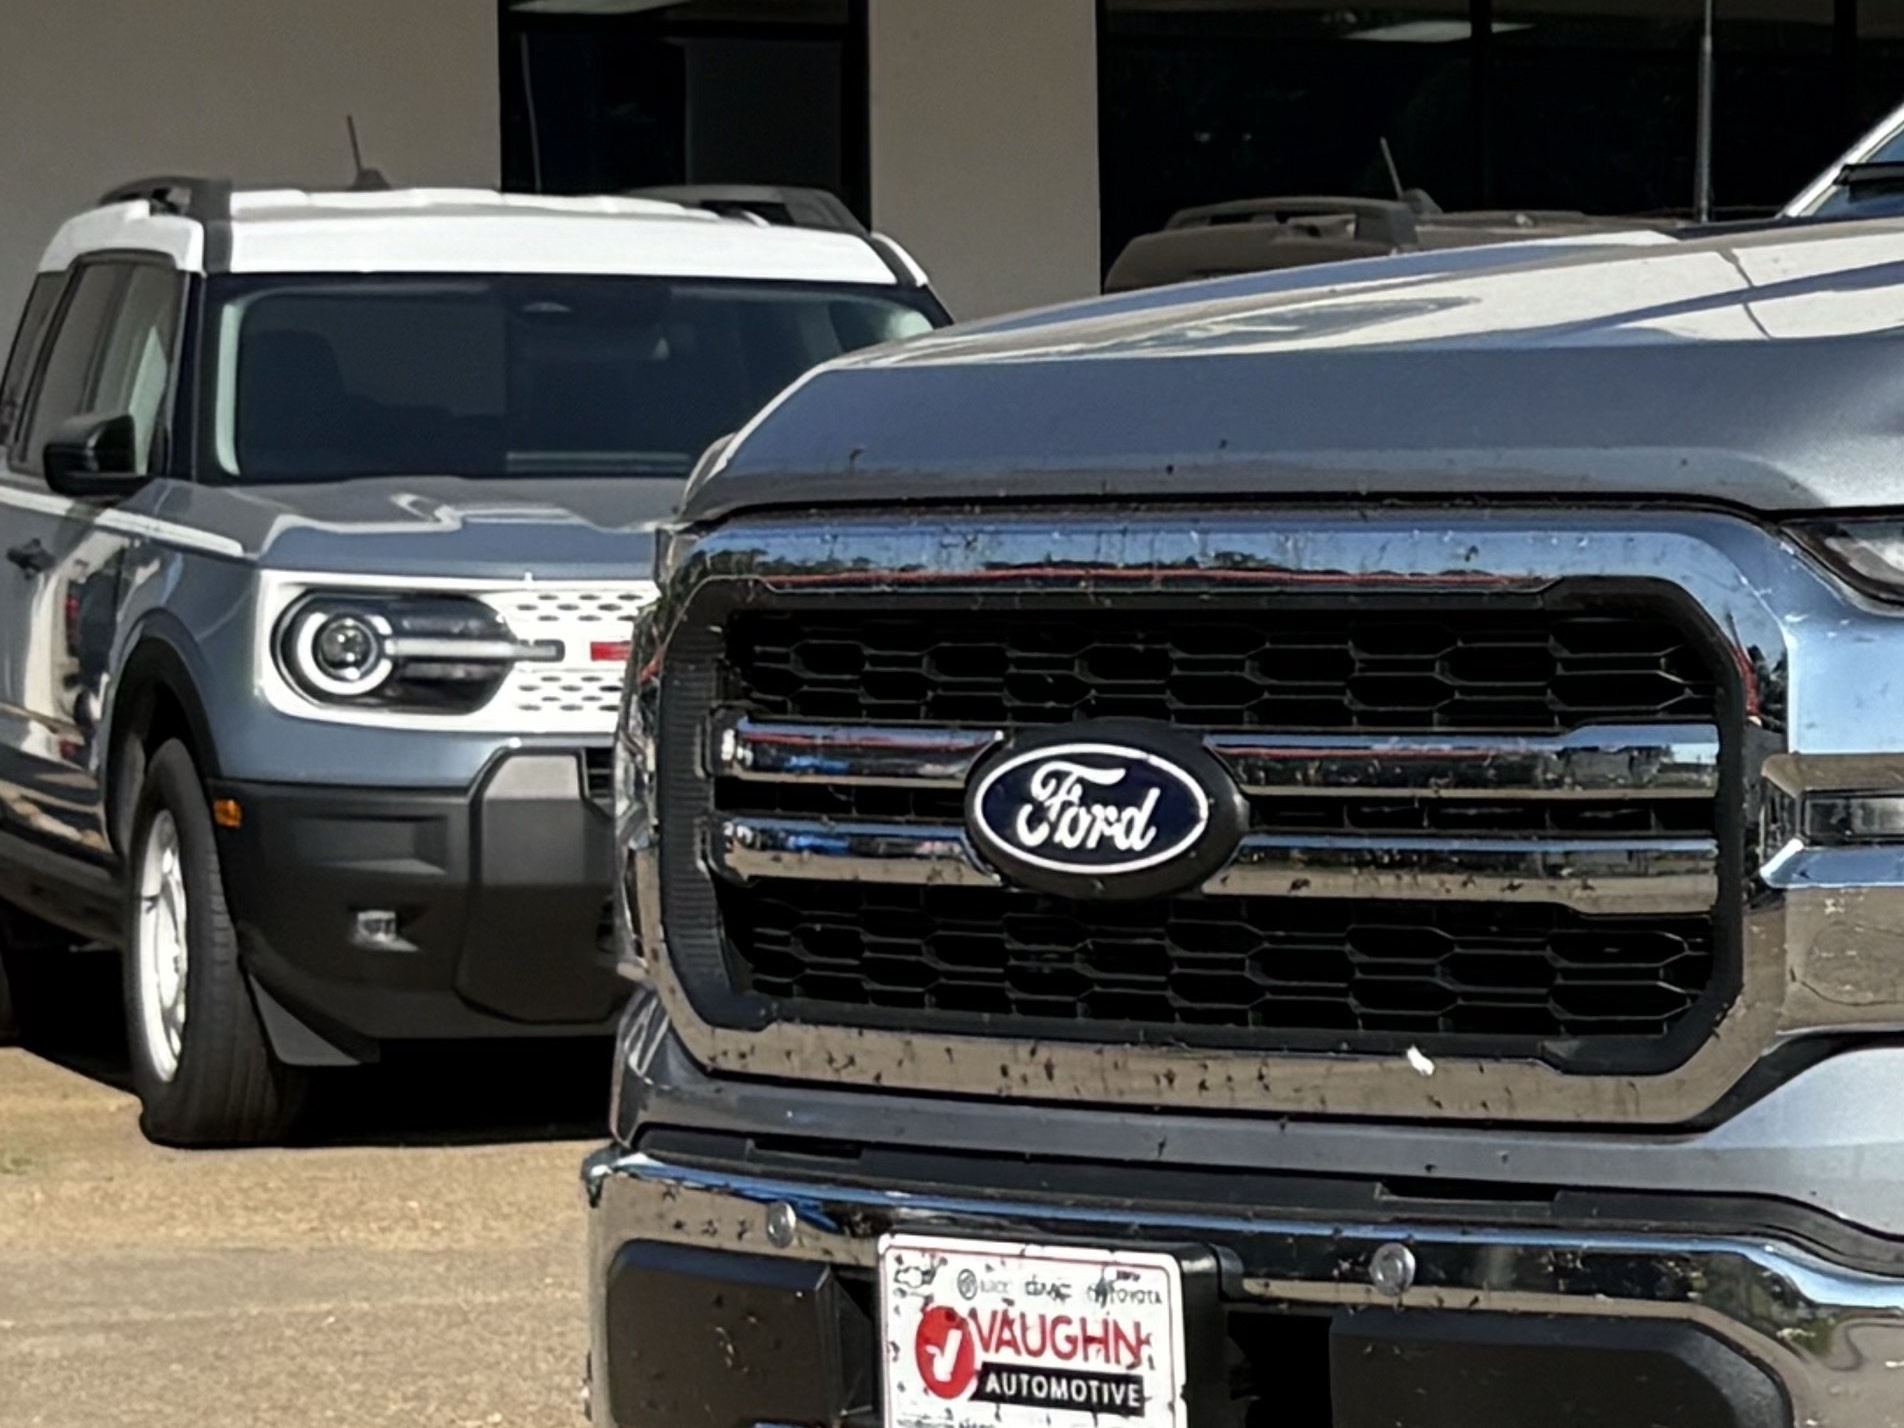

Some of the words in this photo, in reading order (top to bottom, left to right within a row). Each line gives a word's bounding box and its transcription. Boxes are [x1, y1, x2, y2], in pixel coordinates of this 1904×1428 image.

[1016, 760, 1160, 851] Ford
[970, 1307, 1143, 1368] VAUGHN
[984, 1372, 1141, 1408] AUTOMOTIVE
